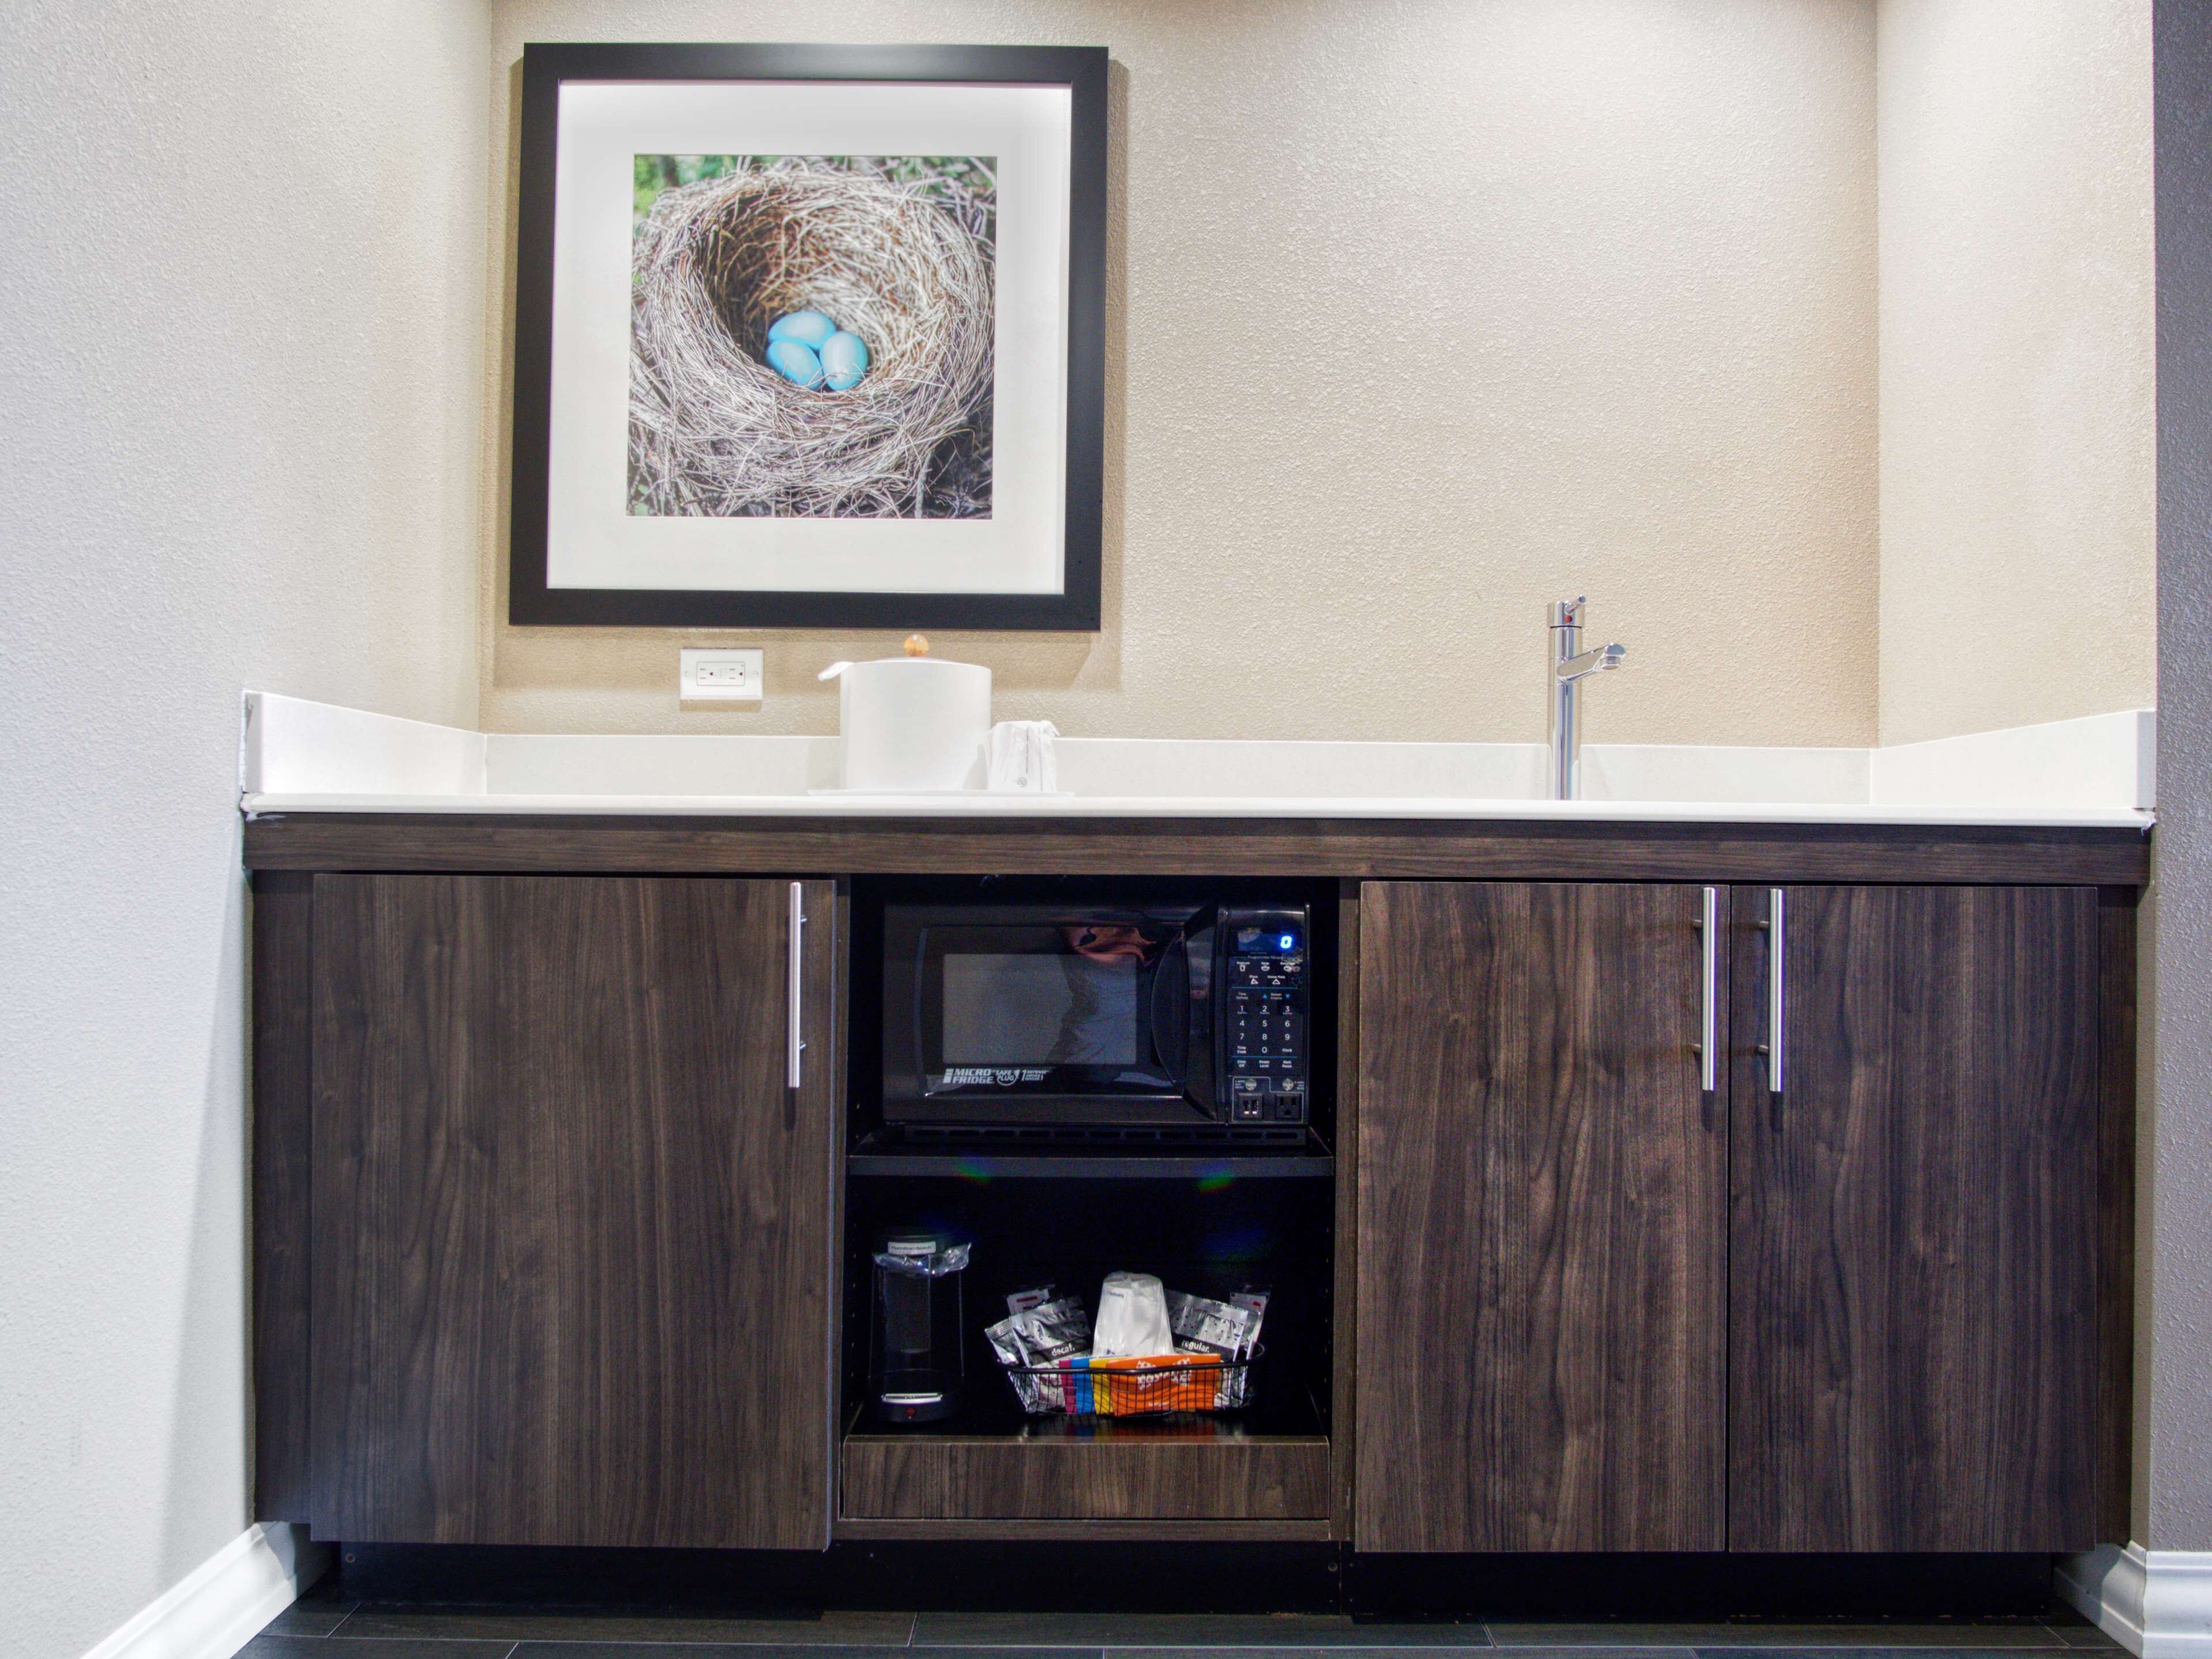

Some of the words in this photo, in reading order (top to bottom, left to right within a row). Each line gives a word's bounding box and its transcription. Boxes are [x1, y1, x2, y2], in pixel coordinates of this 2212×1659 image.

[1280, 935, 1293, 949] 0
[1051, 1343, 1075, 1357] decaf.
[1181, 1339, 1210, 1353] regular.
